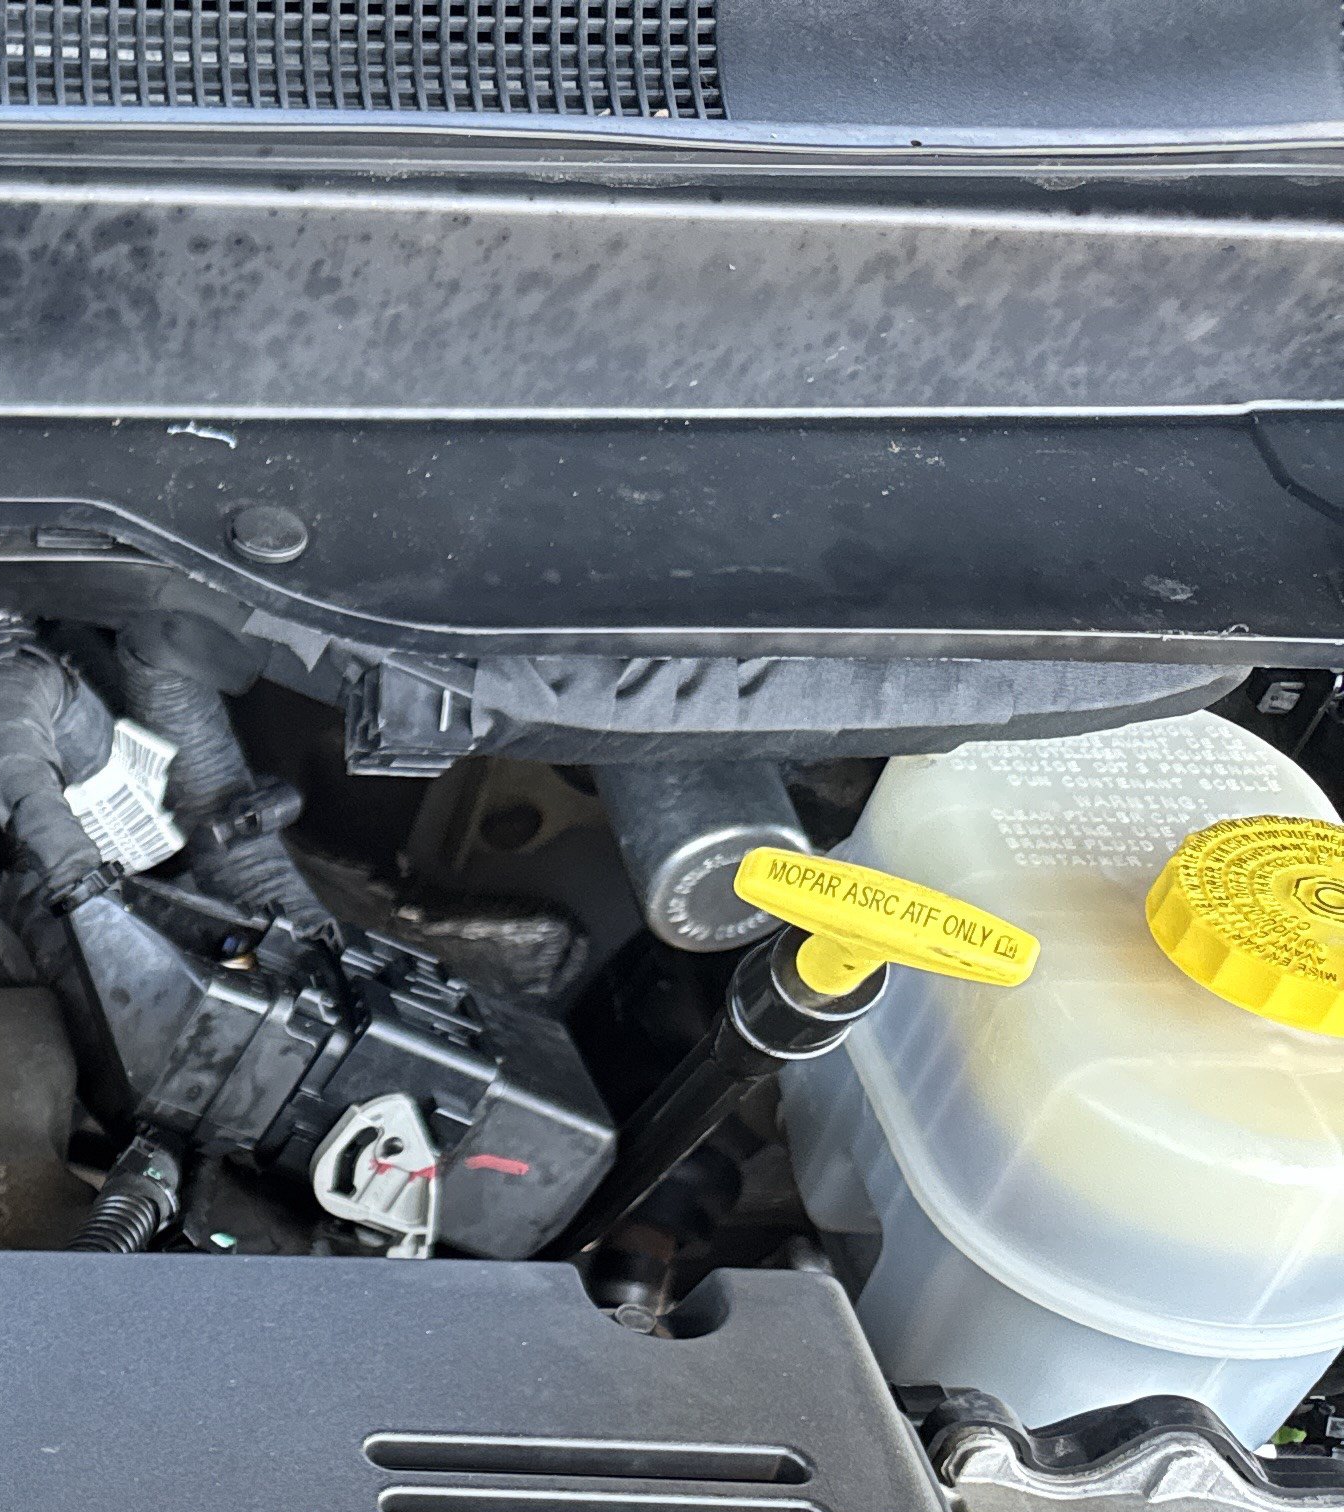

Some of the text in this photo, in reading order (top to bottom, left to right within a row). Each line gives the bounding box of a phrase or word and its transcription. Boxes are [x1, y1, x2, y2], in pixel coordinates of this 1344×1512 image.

[767, 858, 842, 898] MOPAR
[842, 882, 900, 916] ASRC
[900, 901, 941, 928] ATF
[942, 914, 994, 948] ONLY
